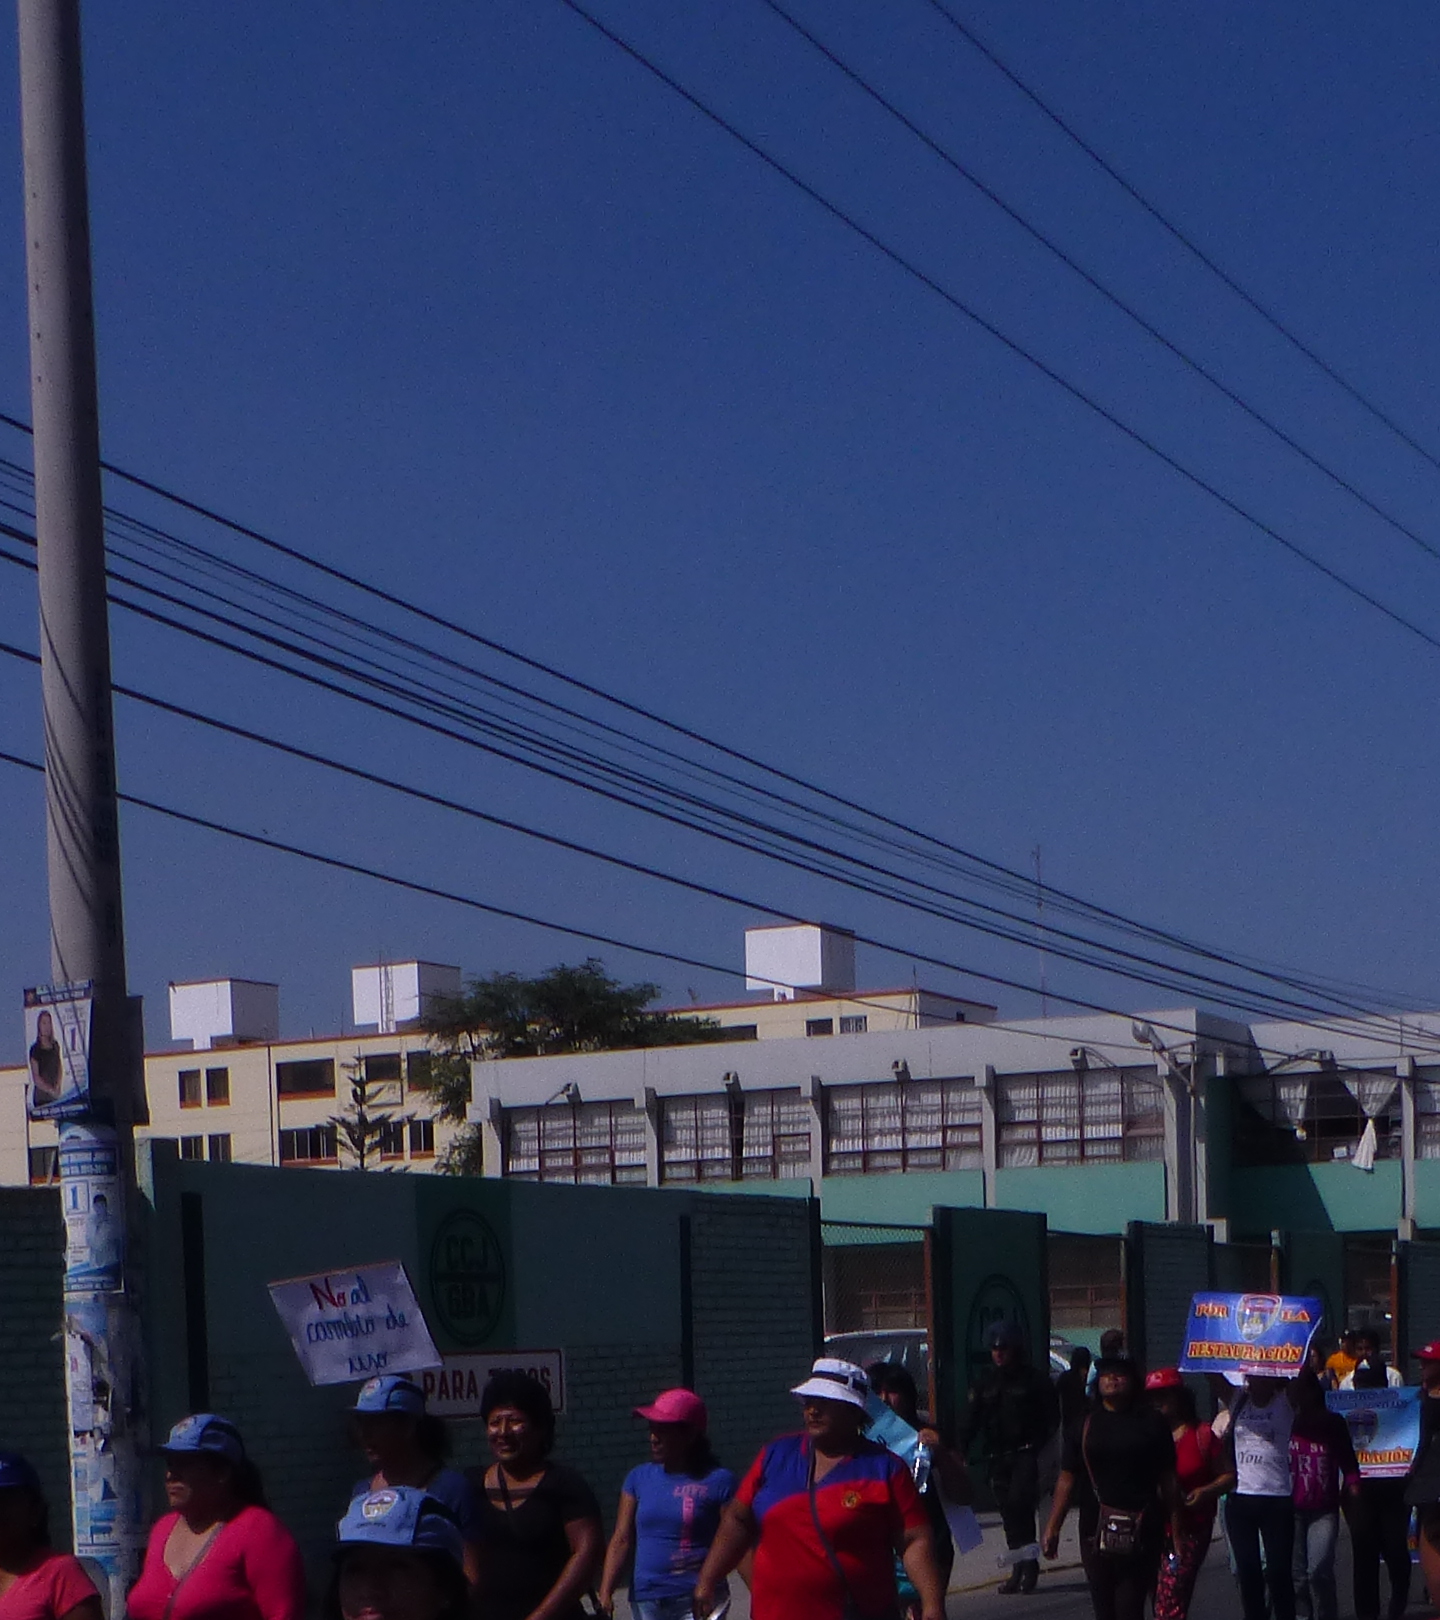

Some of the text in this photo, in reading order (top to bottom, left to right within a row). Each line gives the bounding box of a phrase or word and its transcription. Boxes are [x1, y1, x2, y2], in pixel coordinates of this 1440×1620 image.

[446, 1234, 488, 1271] CCJ
[309, 1274, 371, 1310] No al
[447, 1284, 490, 1319] GBA
[1281, 1310, 1311, 1322] LA
[1187, 1342, 1304, 1363] RESTAURACIÓN
[423, 1369, 479, 1401] PARA
